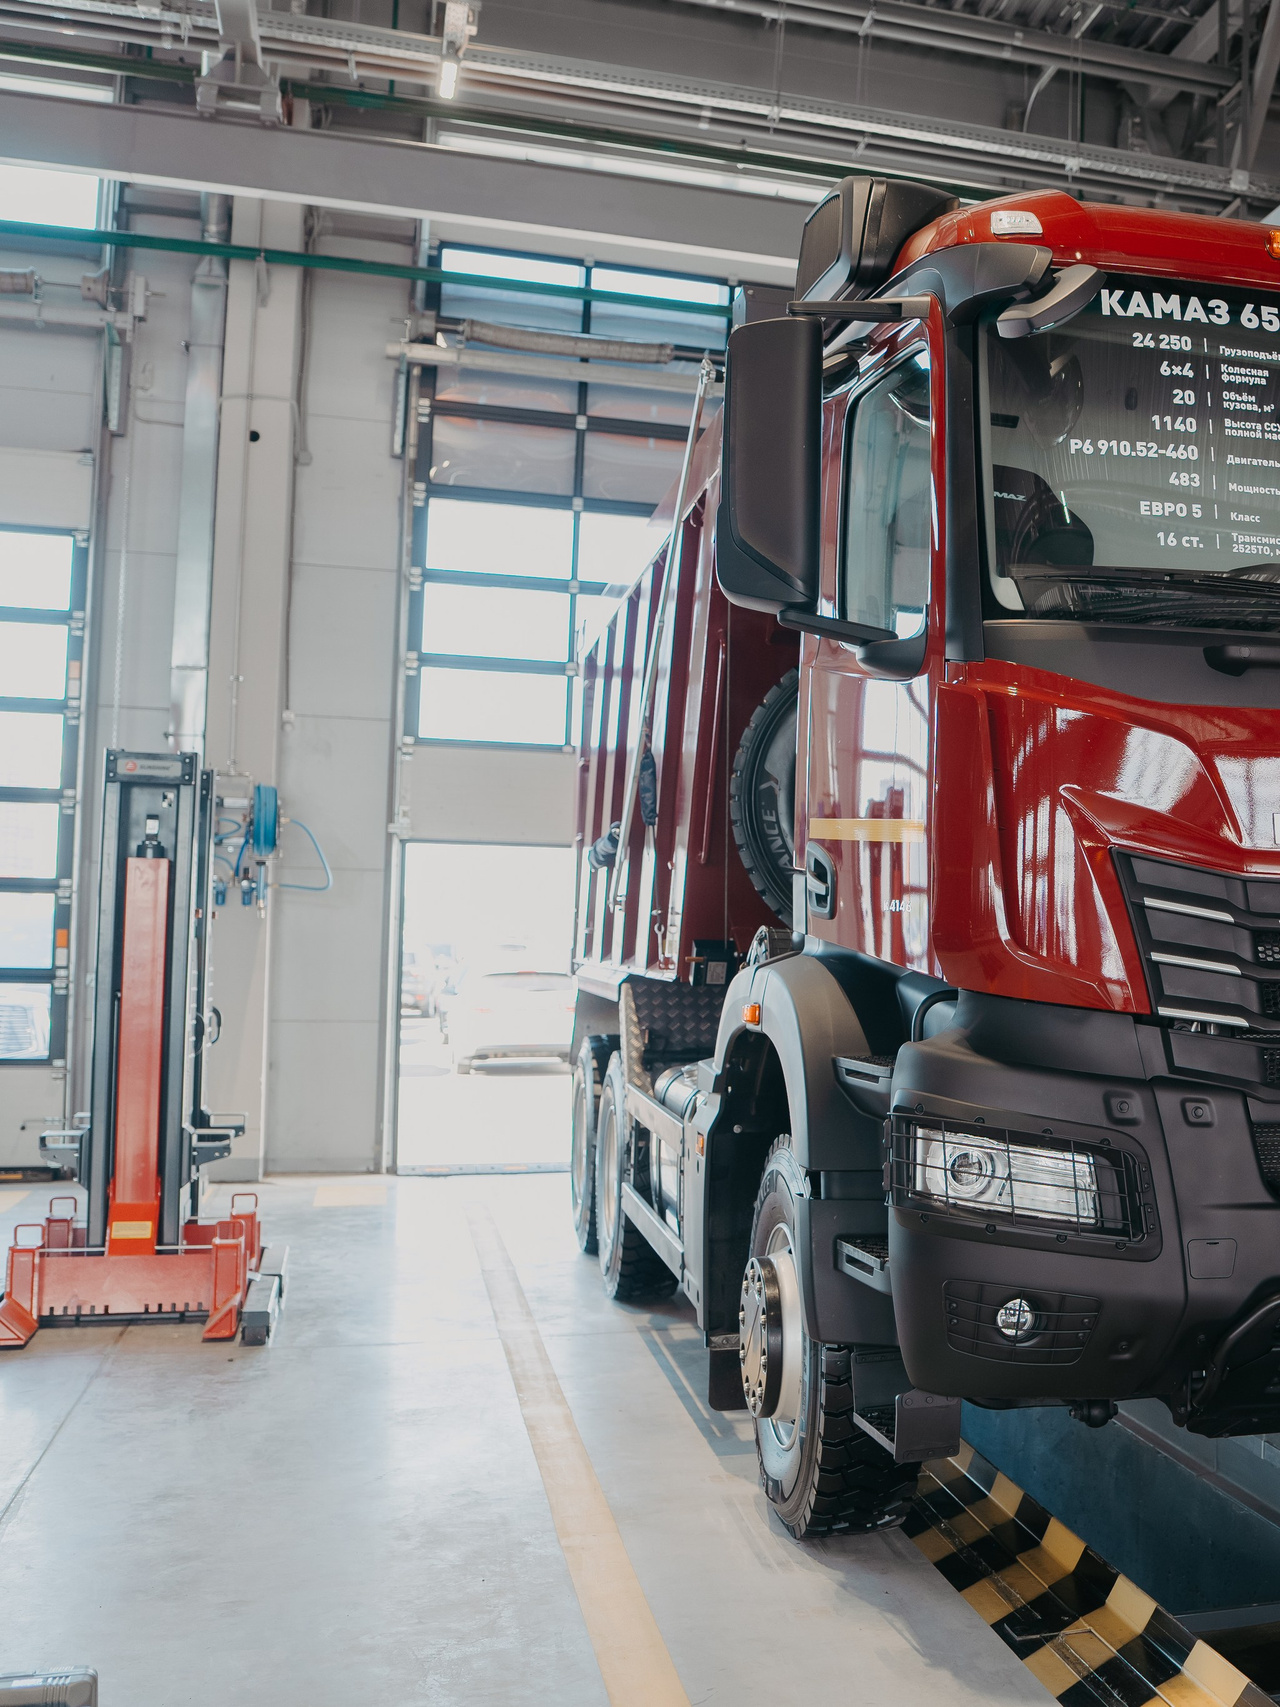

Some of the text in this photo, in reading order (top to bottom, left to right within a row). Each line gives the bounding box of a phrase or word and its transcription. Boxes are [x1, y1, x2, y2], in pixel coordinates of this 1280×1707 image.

[1101, 289, 1230, 325] КАМАЗ
[1133, 332, 1192, 351] 24 250
[1221, 364, 1269, 378] Колесная
[1221, 372, 1267, 385] формула
[1173, 389, 1195, 405] 20
[1223, 391, 1255, 404] Объём
[1223, 400, 1261, 413] кузова,
[1152, 415, 1196, 432] 1140
[1224, 418, 1262, 431] Высота
[1225, 427, 1262, 440] полной
[1098, 440, 1198, 460] 910.52-460
[1227, 455, 1280, 467] Двигатель
[1169, 472, 1200, 487] 483
[1140, 501, 1202, 518] ЕВРО 5
[1231, 512, 1260, 522] Класс
[1157, 532, 1203, 548] 16 ст.
